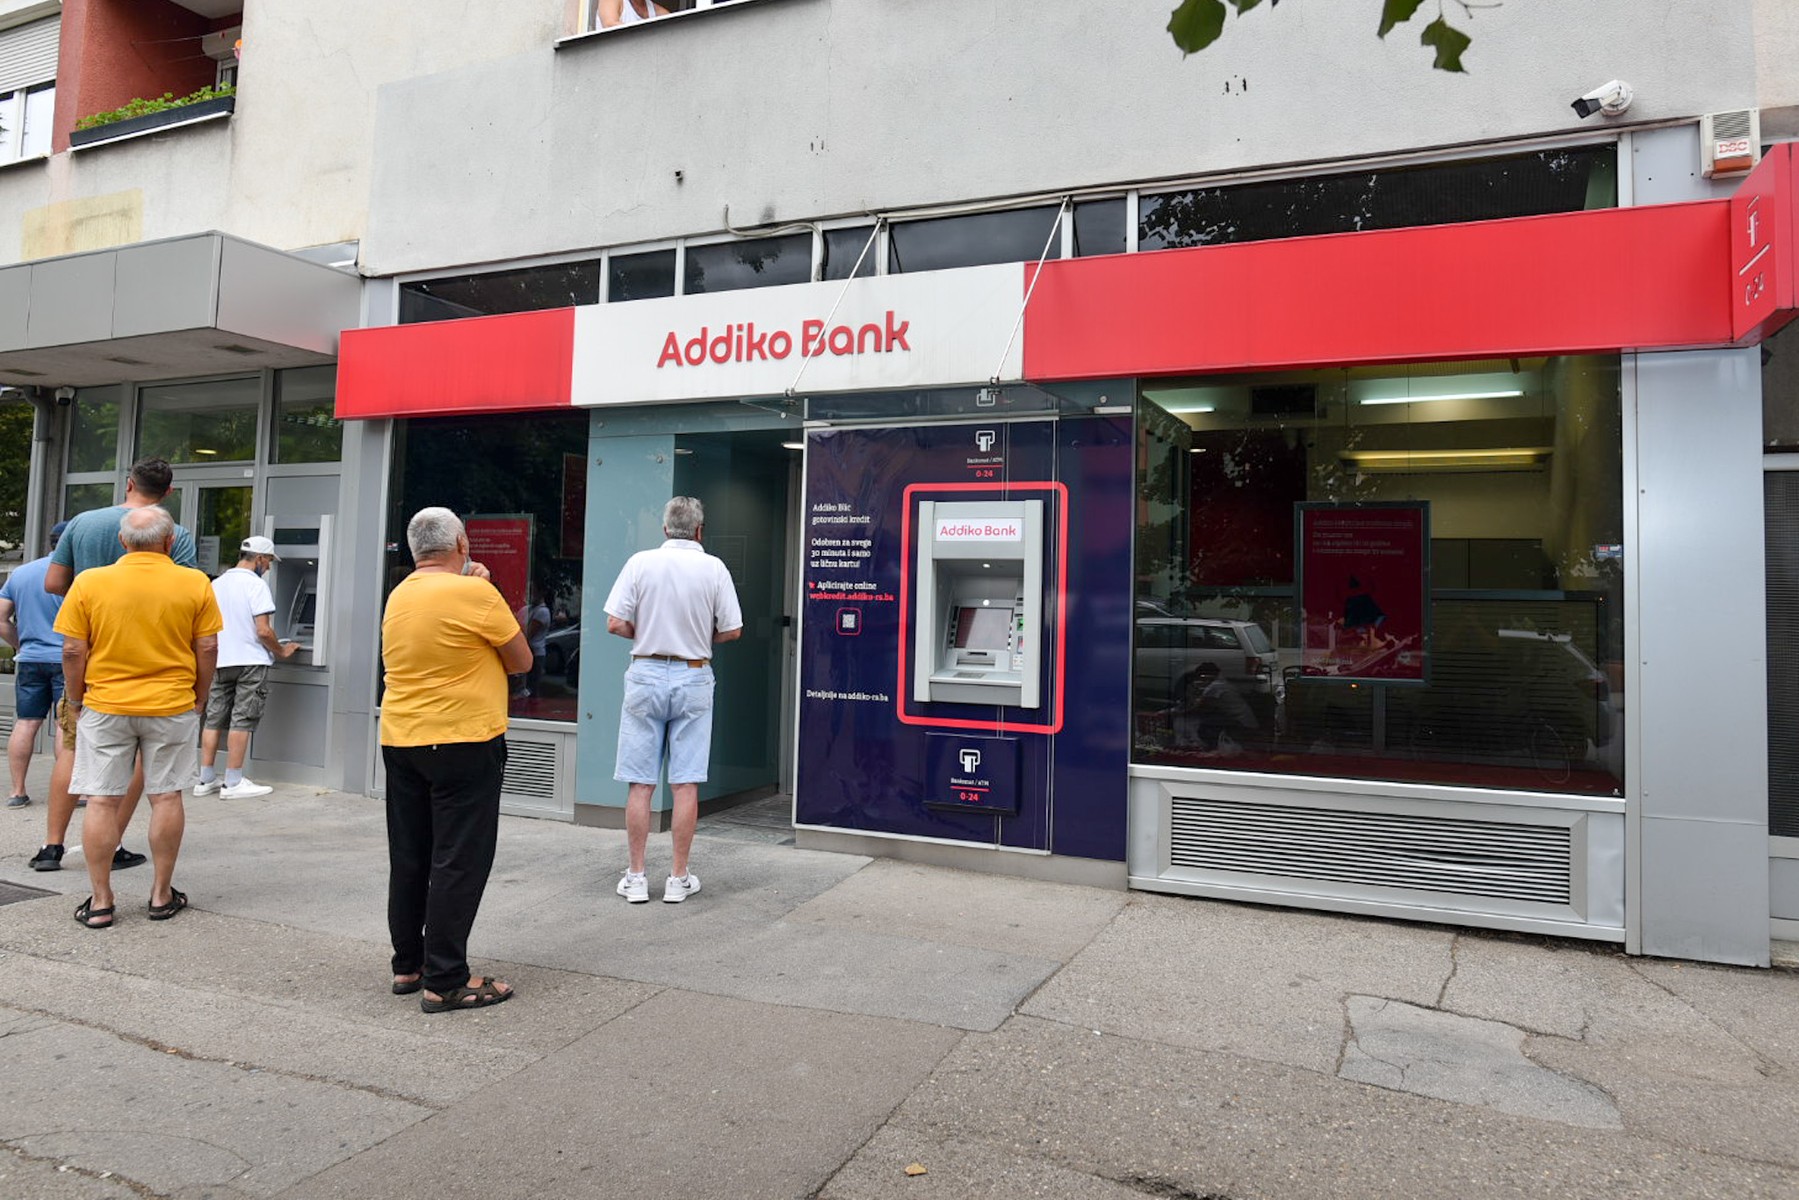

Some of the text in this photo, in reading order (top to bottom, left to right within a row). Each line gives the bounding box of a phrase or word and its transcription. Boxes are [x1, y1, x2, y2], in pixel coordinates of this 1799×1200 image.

[1719, 141, 1748, 154] DSC
[656, 310, 911, 368] Addiko Bank
[975, 469, 994, 478] 0-24
[812, 503, 837, 512] Addiko
[812, 515, 871, 526] gotovinski kredit
[940, 524, 1016, 536] Addiko Bank
[811, 538, 841, 547] Odobren
[851, 540, 872, 549] svega
[811, 550, 820, 558] 30
[821, 549, 846, 557] minuta
[851, 550, 871, 558] samo
[817, 581, 877, 591] Aplicirajte online
[806, 689, 889, 702] Detaljnije na addiko-rs.ba
[960, 792, 979, 801] 0-24
